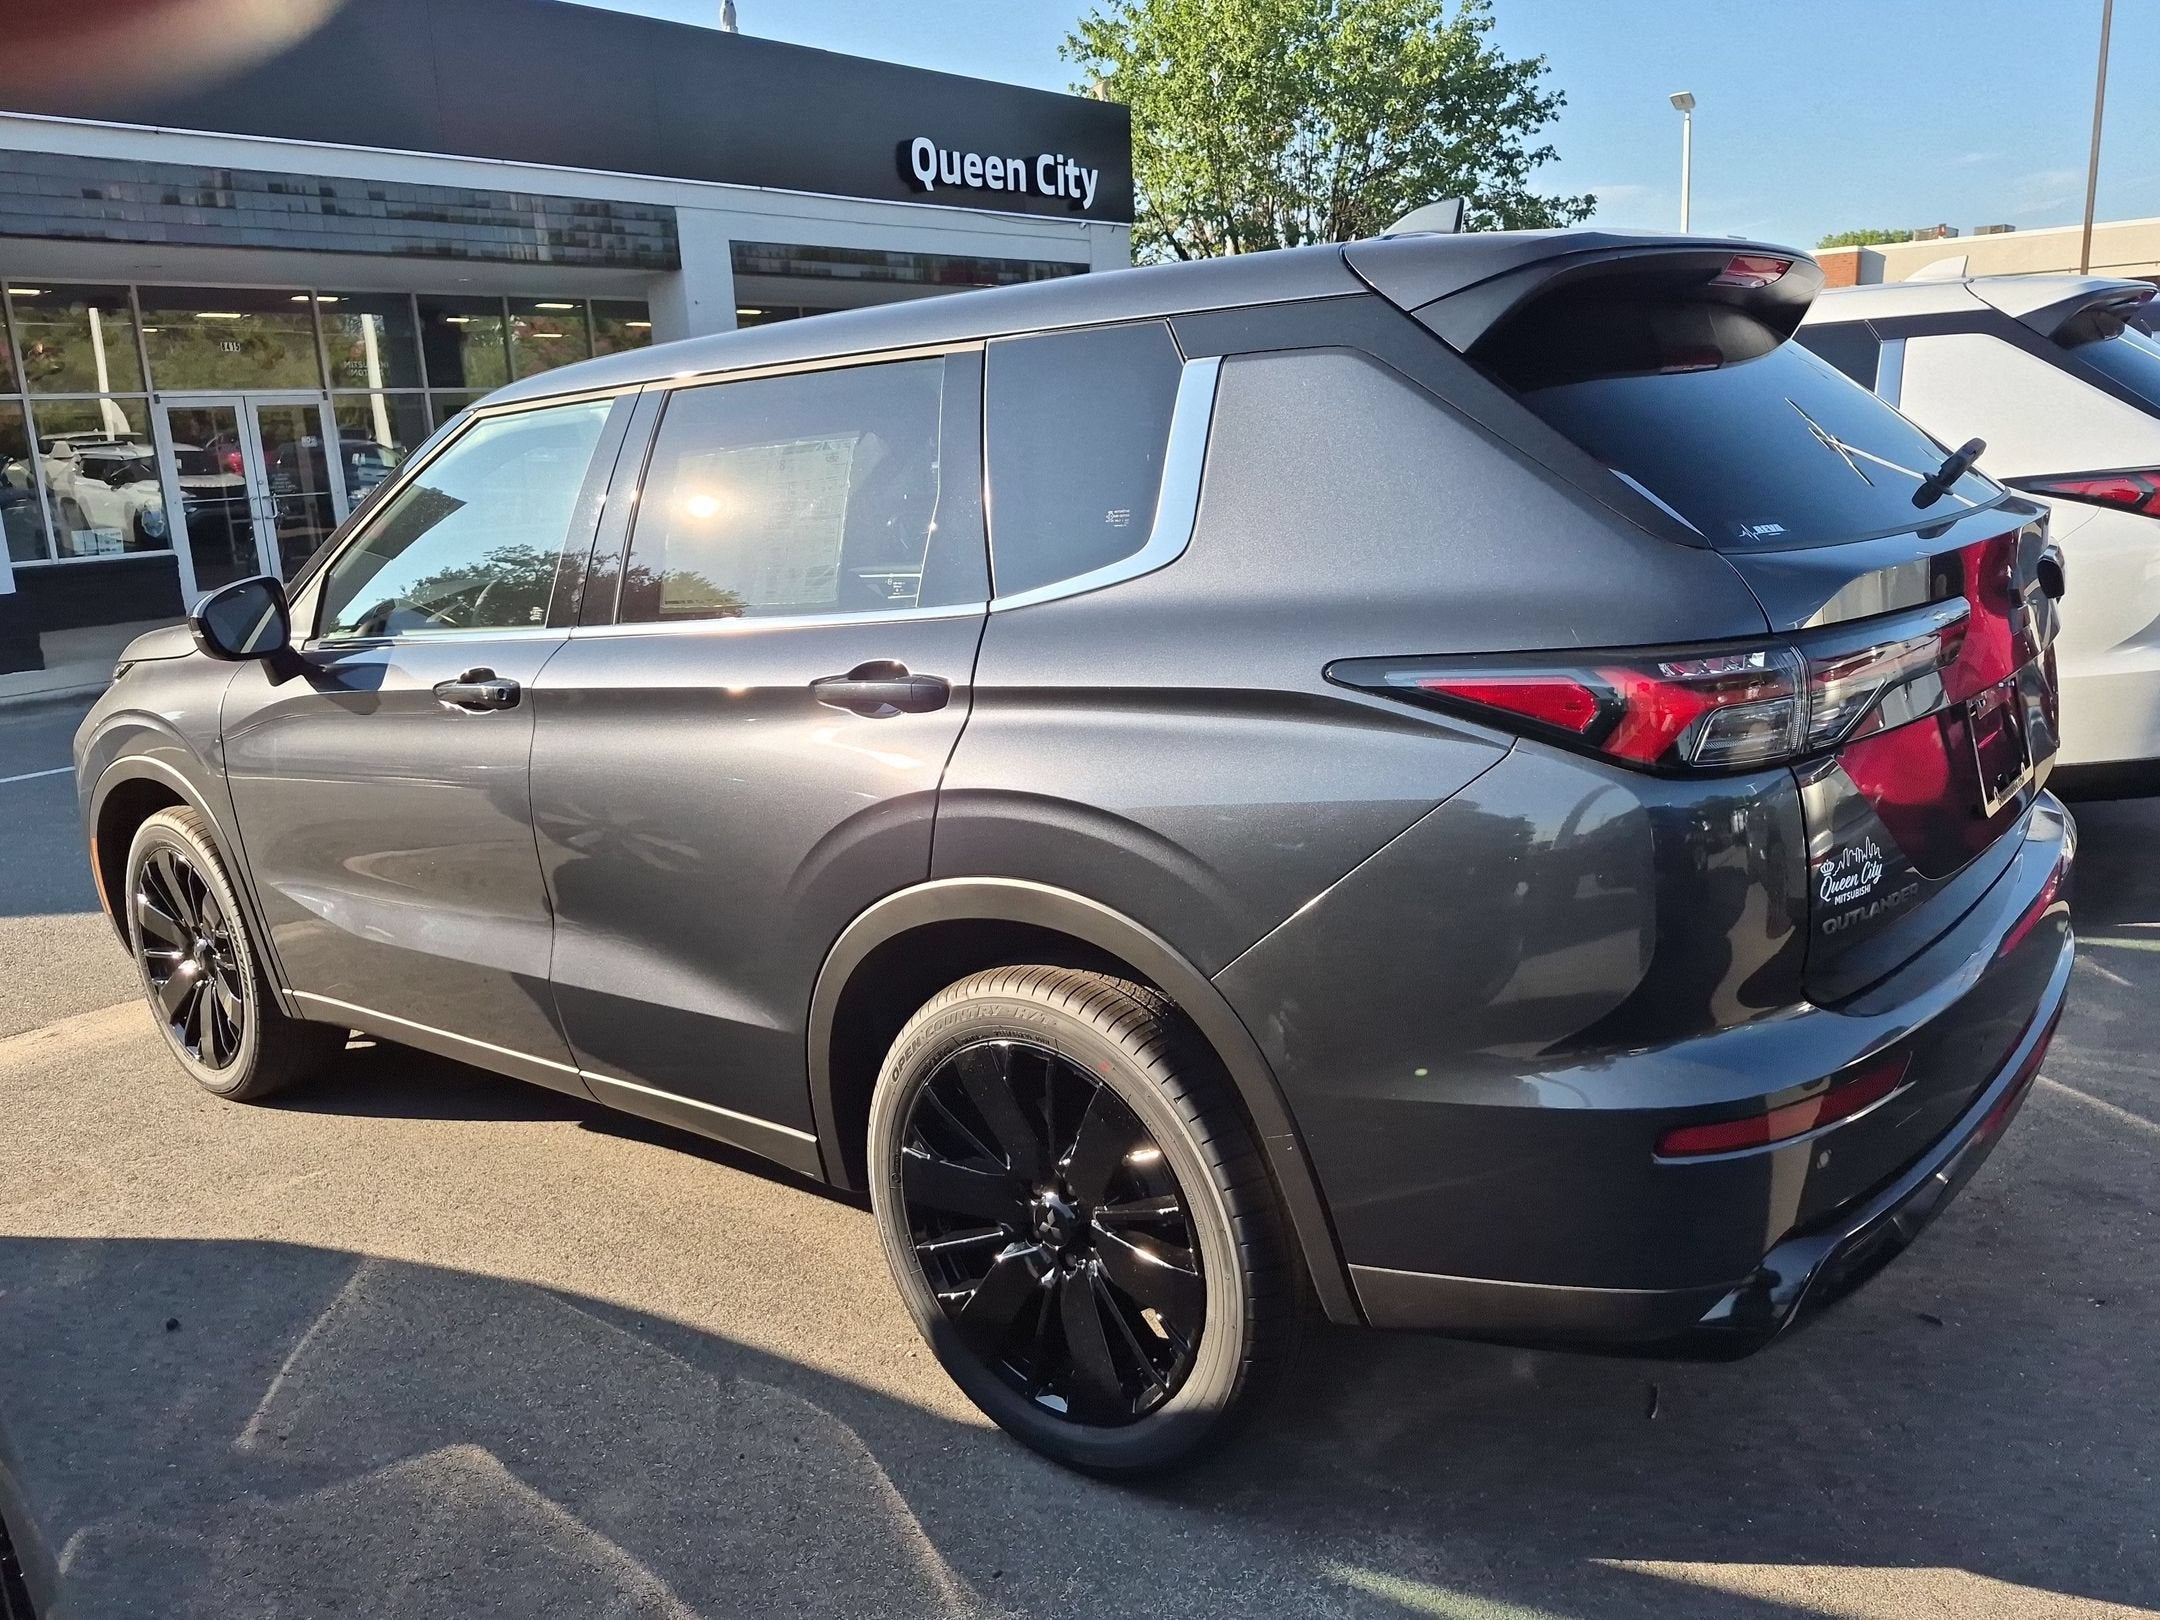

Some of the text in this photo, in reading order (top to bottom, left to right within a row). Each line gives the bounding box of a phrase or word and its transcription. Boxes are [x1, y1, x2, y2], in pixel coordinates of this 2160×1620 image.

[911, 136, 1099, 210] Queen City
[1820, 860, 1883, 902] Queen City
[1834, 883, 1871, 906] MITSUBISHI
[1822, 882, 1918, 935] OUTLANDER
[891, 1036, 923, 1083] OPEN
[924, 1003, 1001, 1040] COUNTRY
